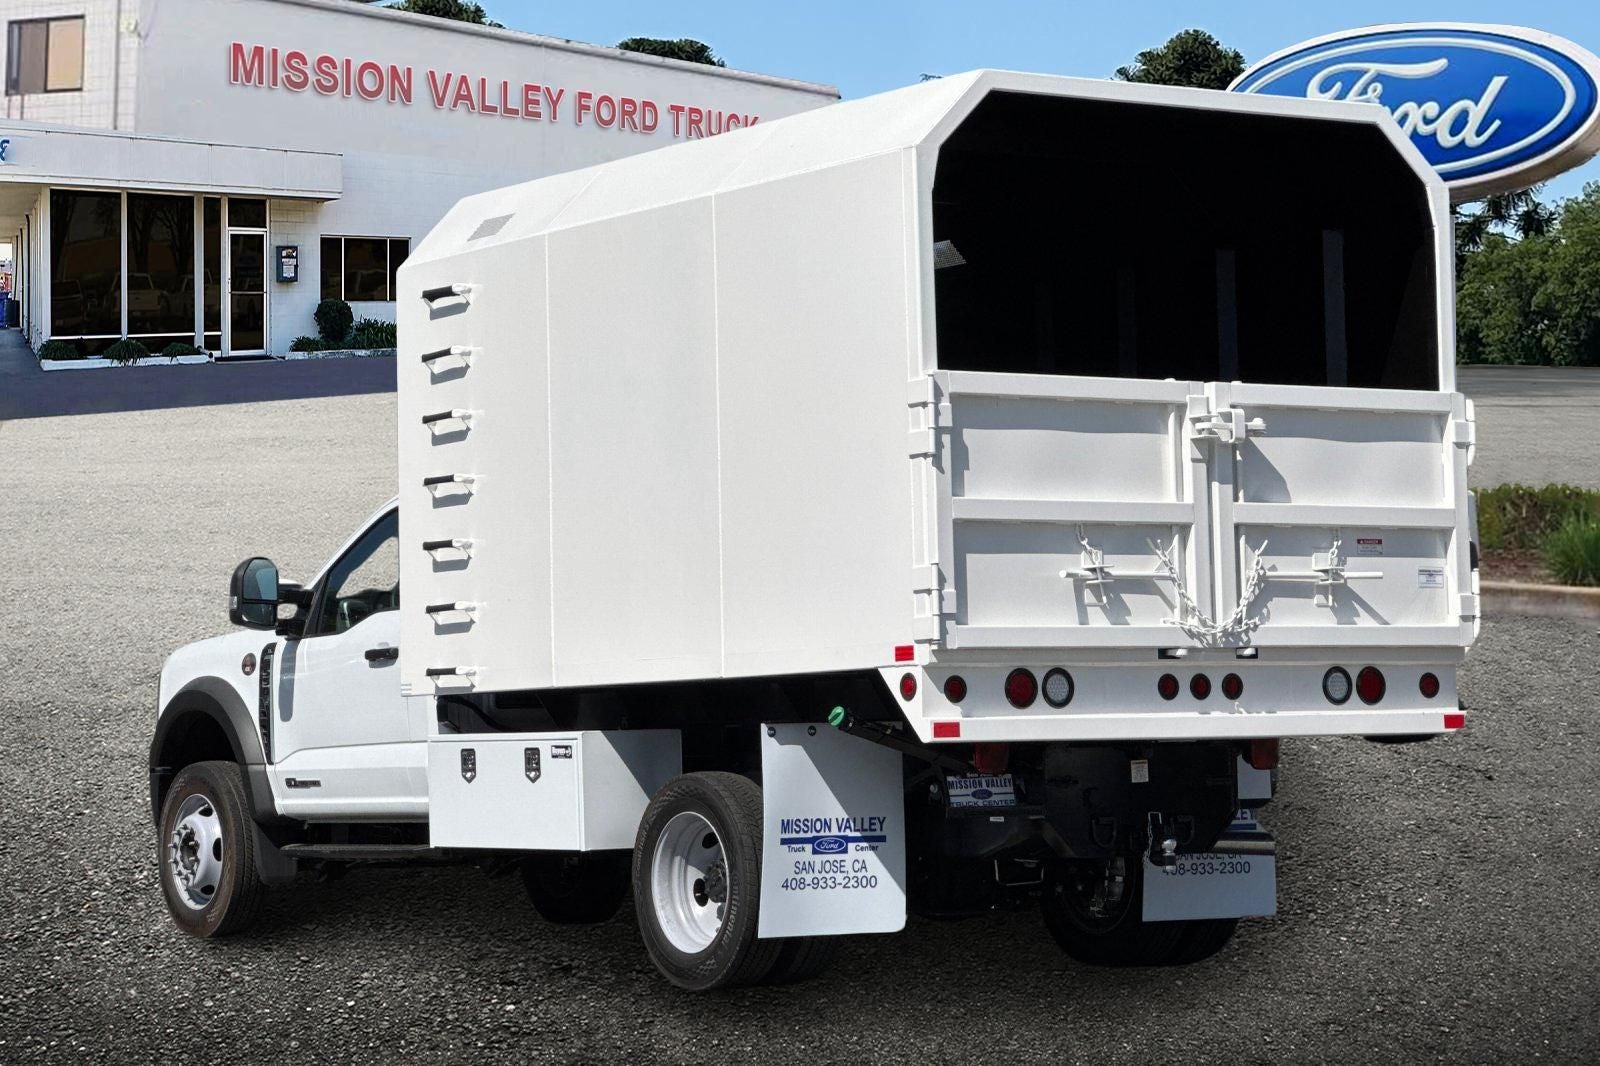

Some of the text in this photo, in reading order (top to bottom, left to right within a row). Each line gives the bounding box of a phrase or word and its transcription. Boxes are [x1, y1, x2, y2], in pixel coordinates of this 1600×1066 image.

[229, 41, 413, 104] MISSION
[427, 69, 565, 121] VALLEY
[575, 90, 660, 134] FORD
[1306, 57, 1509, 149] Frd
[948, 778, 1012, 789] MISSION VALLEY
[781, 817, 886, 834] MISSION VALLEY
[787, 844, 879, 853] Truck Center
[794, 859, 868, 875] SAN JOSE, CA
[781, 875, 877, 890] 408-933-2300
